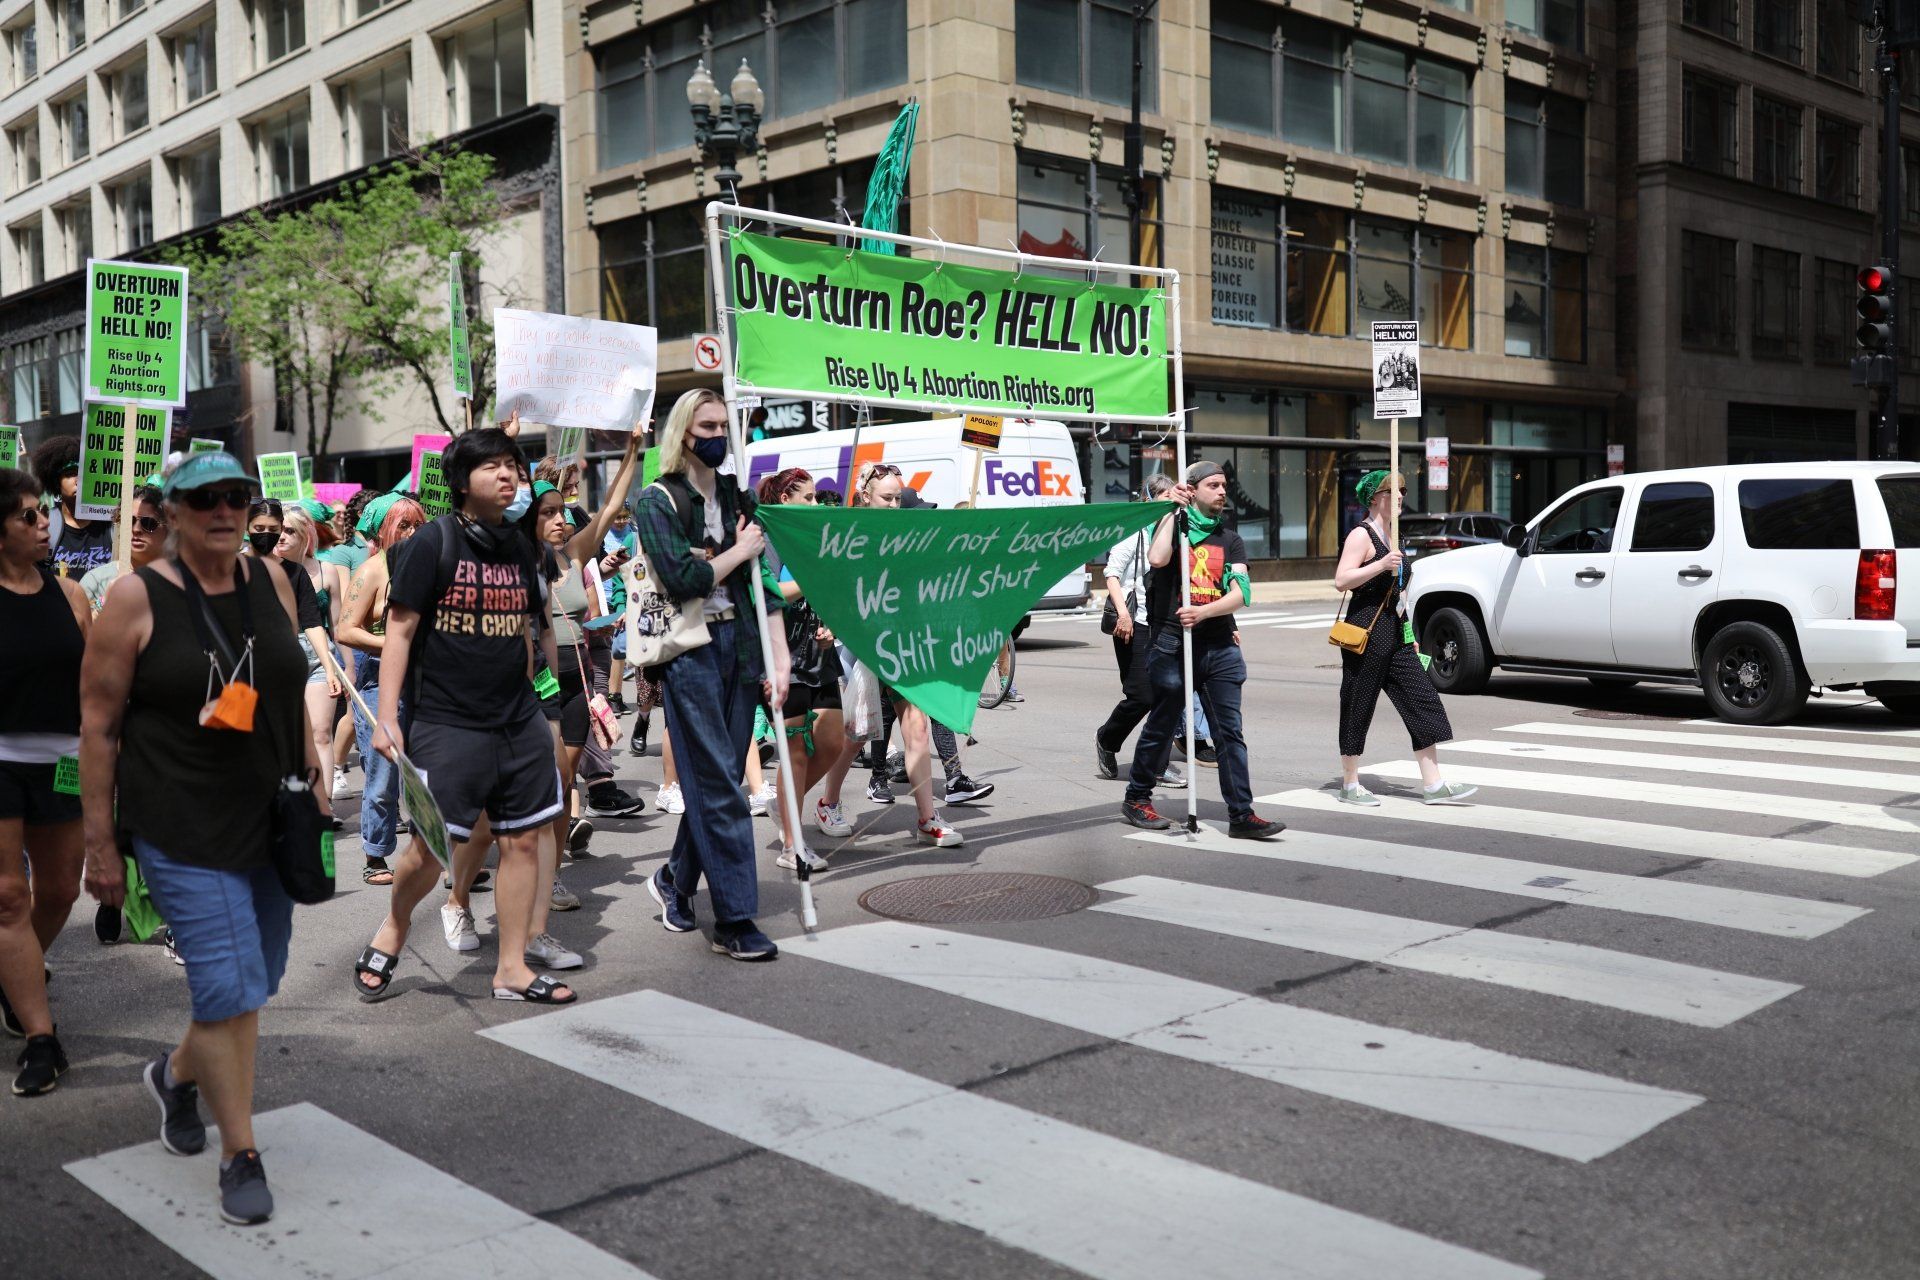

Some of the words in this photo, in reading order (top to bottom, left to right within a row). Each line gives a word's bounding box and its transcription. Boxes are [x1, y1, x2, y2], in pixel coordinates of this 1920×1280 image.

[1211, 217, 1242, 233] SINCE
[1211, 235, 1257, 254] FOREVER
[1211, 252, 1255, 271] CLASSIC
[95, 272, 179, 297] OVERTURN
[1211, 271, 1242, 287] SINCE
[113, 295, 144, 316] ROE
[150, 299, 161, 317] ?
[735, 253, 892, 333] Overturn
[900, 281, 987, 343] Roe?
[994, 288, 1082, 354] HELL
[1090, 300, 1152, 358] NO!
[1211, 289, 1257, 307] FOREVER
[1211, 307, 1255, 323] CLASSIC
[101, 316, 139, 337] HELL
[145, 320, 172, 340] NO!
[1375, 331, 1397, 340] HELL
[1398, 331, 1415, 340] NO!
[108, 348, 132, 361] Rise
[136, 350, 151, 365] Up
[155, 352, 162, 363] 4
[110, 364, 160, 378] Abortion
[105, 379, 166, 396] Rights.org
[825, 356, 870, 390] Rise
[872, 362, 900, 399] Up
[903, 365, 918, 394] 4
[922, 367, 1002, 401] Abortion
[1003, 373, 1096, 414] Rights.org
[95, 410, 157, 431] ABOION
[763, 399, 806, 430] ANS
[970, 416, 999, 428] APOLOGY!
[87, 433, 104, 450] ON
[108, 434, 162, 455] DEAND
[89, 459, 98, 474] &
[102, 458, 157, 477] WITOUT
[426, 457, 441, 469] ¡AB
[985, 460, 1073, 497] FedEx
[427, 488, 441, 502] SIN
[818, 521, 869, 560] We
[879, 527, 940, 556] will
[946, 527, 1001, 556] not
[454, 560, 477, 584] ER
[481, 563, 520, 586] BODY
[482, 588, 529, 611] RIGHT
[856, 568, 901, 620] We
[918, 565, 971, 602] will
[972, 560, 1041, 598] shut
[435, 609, 476, 635] HER
[481, 614, 525, 637] CHOI
[950, 624, 1006, 668] down
